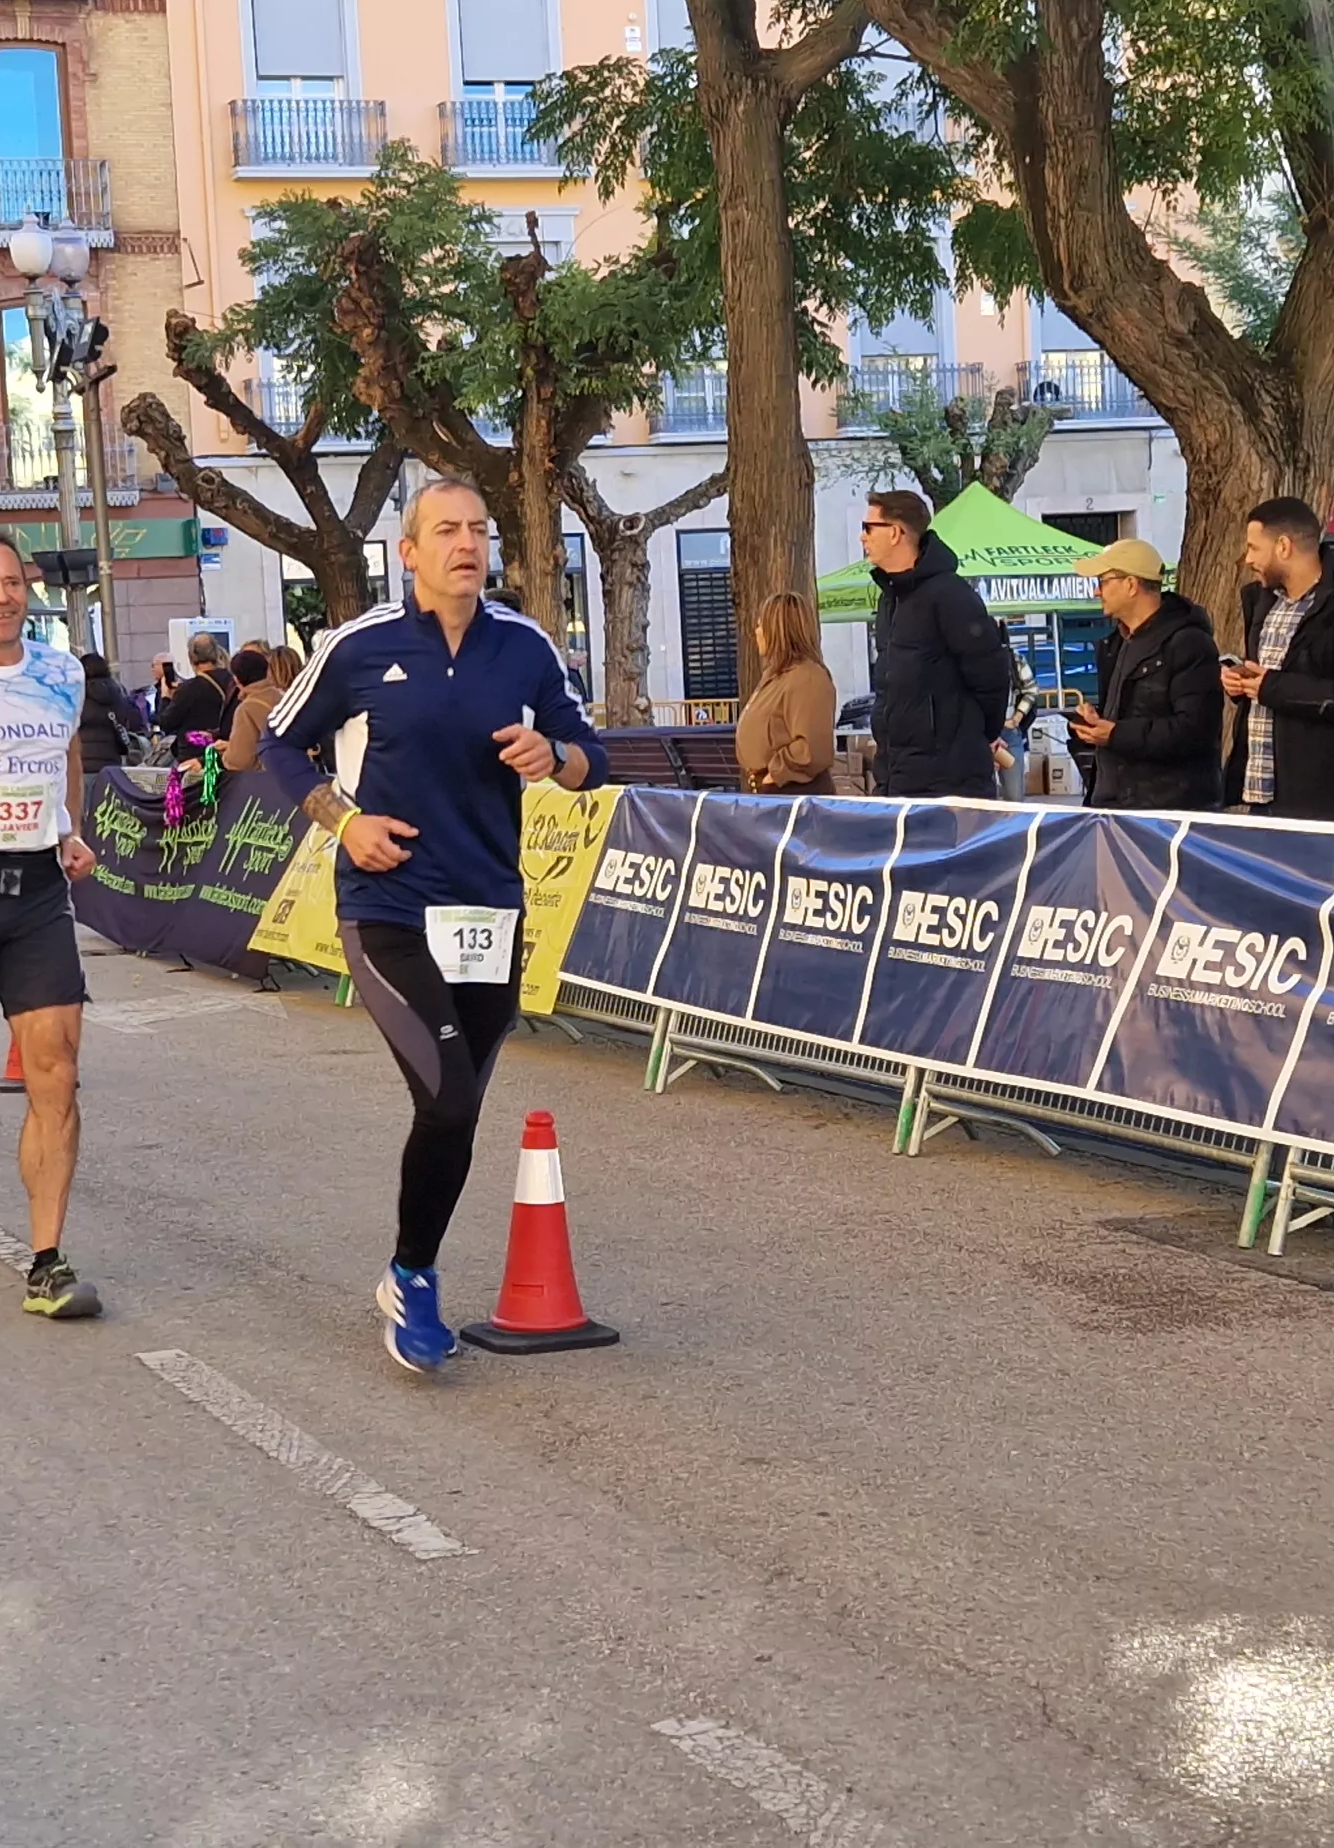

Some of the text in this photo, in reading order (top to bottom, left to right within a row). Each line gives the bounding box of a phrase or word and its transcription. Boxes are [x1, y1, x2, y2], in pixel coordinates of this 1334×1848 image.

[1085, 497, 1094, 511] 2
[984, 545, 1078, 557] FARTLECK
[990, 576, 1100, 601] AVITUALLAMIEN
[7, 755, 60, 775] Ercros
[0, 821, 40, 832] JAVIER
[616, 851, 676, 903] ESIC
[704, 865, 767, 919] ESIC
[801, 878, 874, 935] ESIC
[917, 893, 999, 953] ESIC
[453, 927, 494, 950] 133
[1038, 907, 1133, 969] ESIC
[1185, 926, 1307, 995] ESIC
